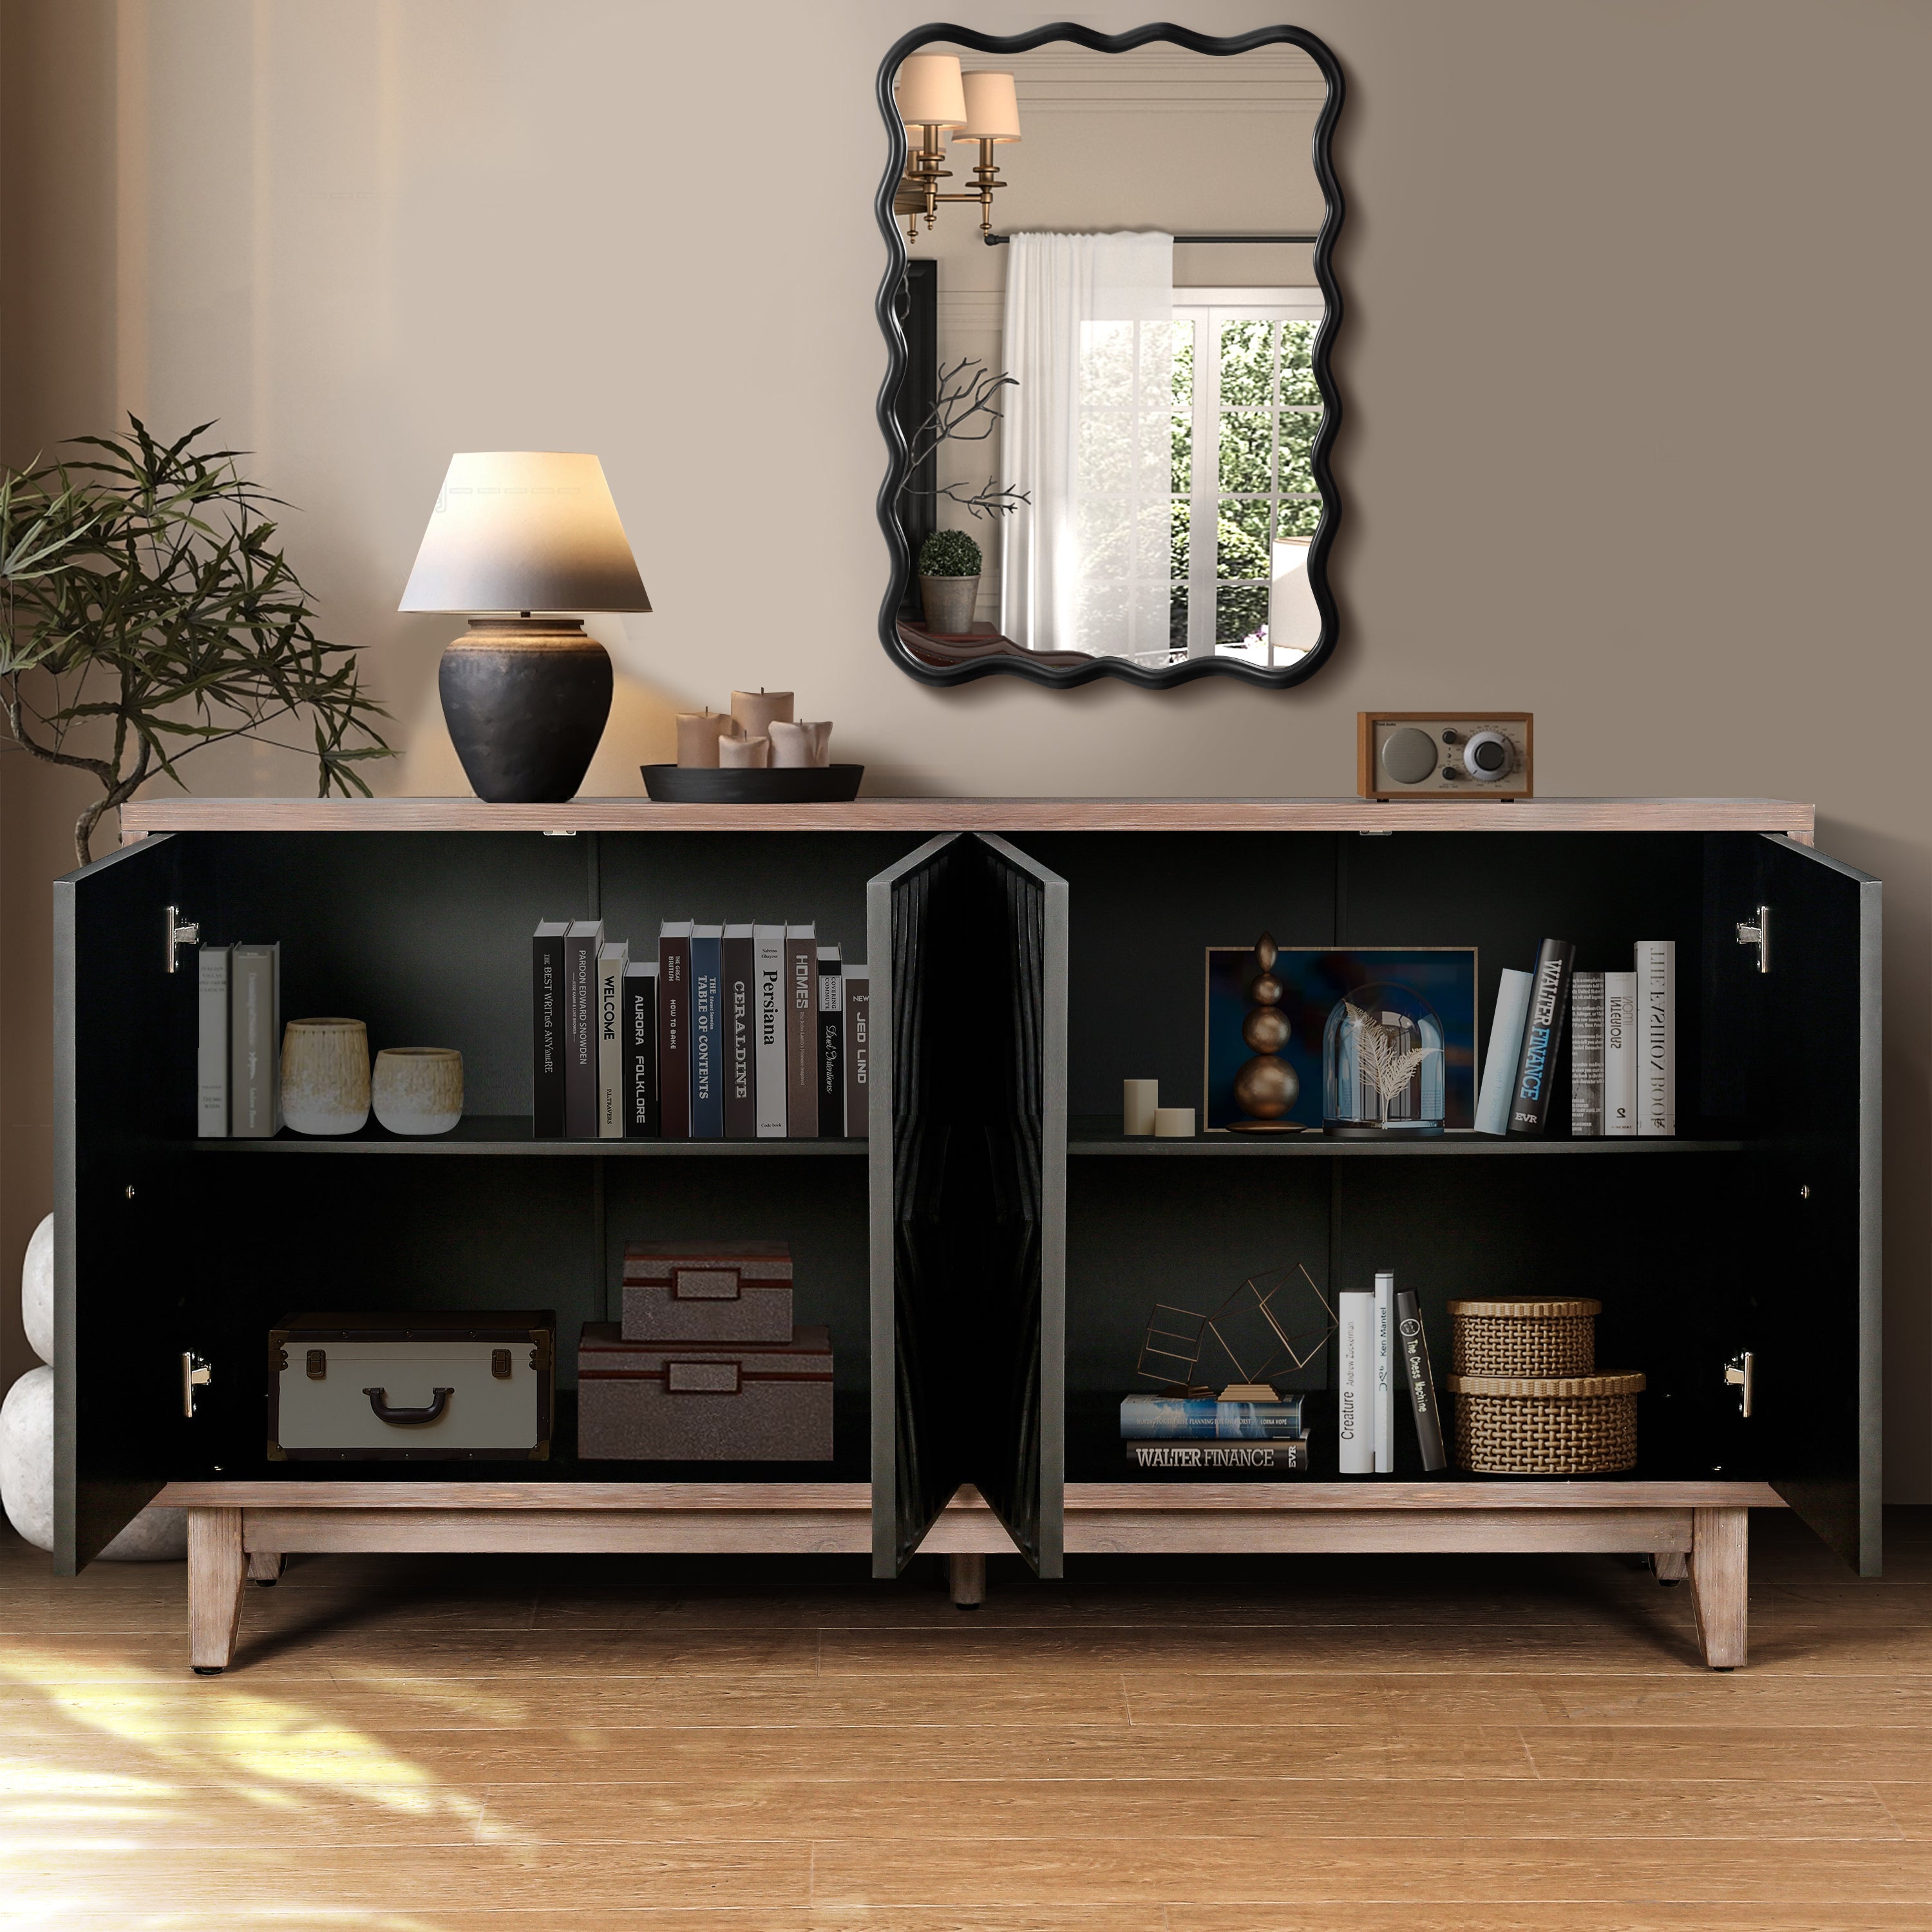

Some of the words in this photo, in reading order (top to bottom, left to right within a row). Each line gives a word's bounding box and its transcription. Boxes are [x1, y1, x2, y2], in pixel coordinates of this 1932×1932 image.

[544, 967, 552, 990] BEST
[698, 975, 708, 1012] TABLE
[796, 954, 808, 1009] HOMES
[1533, 959, 1562, 1027] WALTER
[603, 976, 615, 1040] WELCOME
[634, 995, 644, 1045] AURORA
[670, 1019, 676, 1027] TO
[698, 1016, 708, 1032] OF
[762, 970, 779, 1045] Persiana
[825, 1025, 837, 1050] Duel
[857, 1012, 866, 1043] JED
[698, 1035, 709, 1099] CONTENTS
[825, 1050, 837, 1094] Intentions
[857, 1049, 867, 1084] LIND
[1520, 1025, 1550, 1101] FINANCE
[635, 1056, 645, 1123] FOLKLORE
[1346, 1321, 1355, 1359] Zuckerman
[1406, 1339, 1418, 1356] The
[1346, 1361, 1355, 1387] Andrew
[1410, 1356, 1421, 1380] Chess
[1341, 1391, 1354, 1440] Creature
[1416, 1381, 1427, 1413] Machine
[1136, 1448, 1202, 1467] WALTER
[1204, 1449, 1274, 1467] FINANCE
